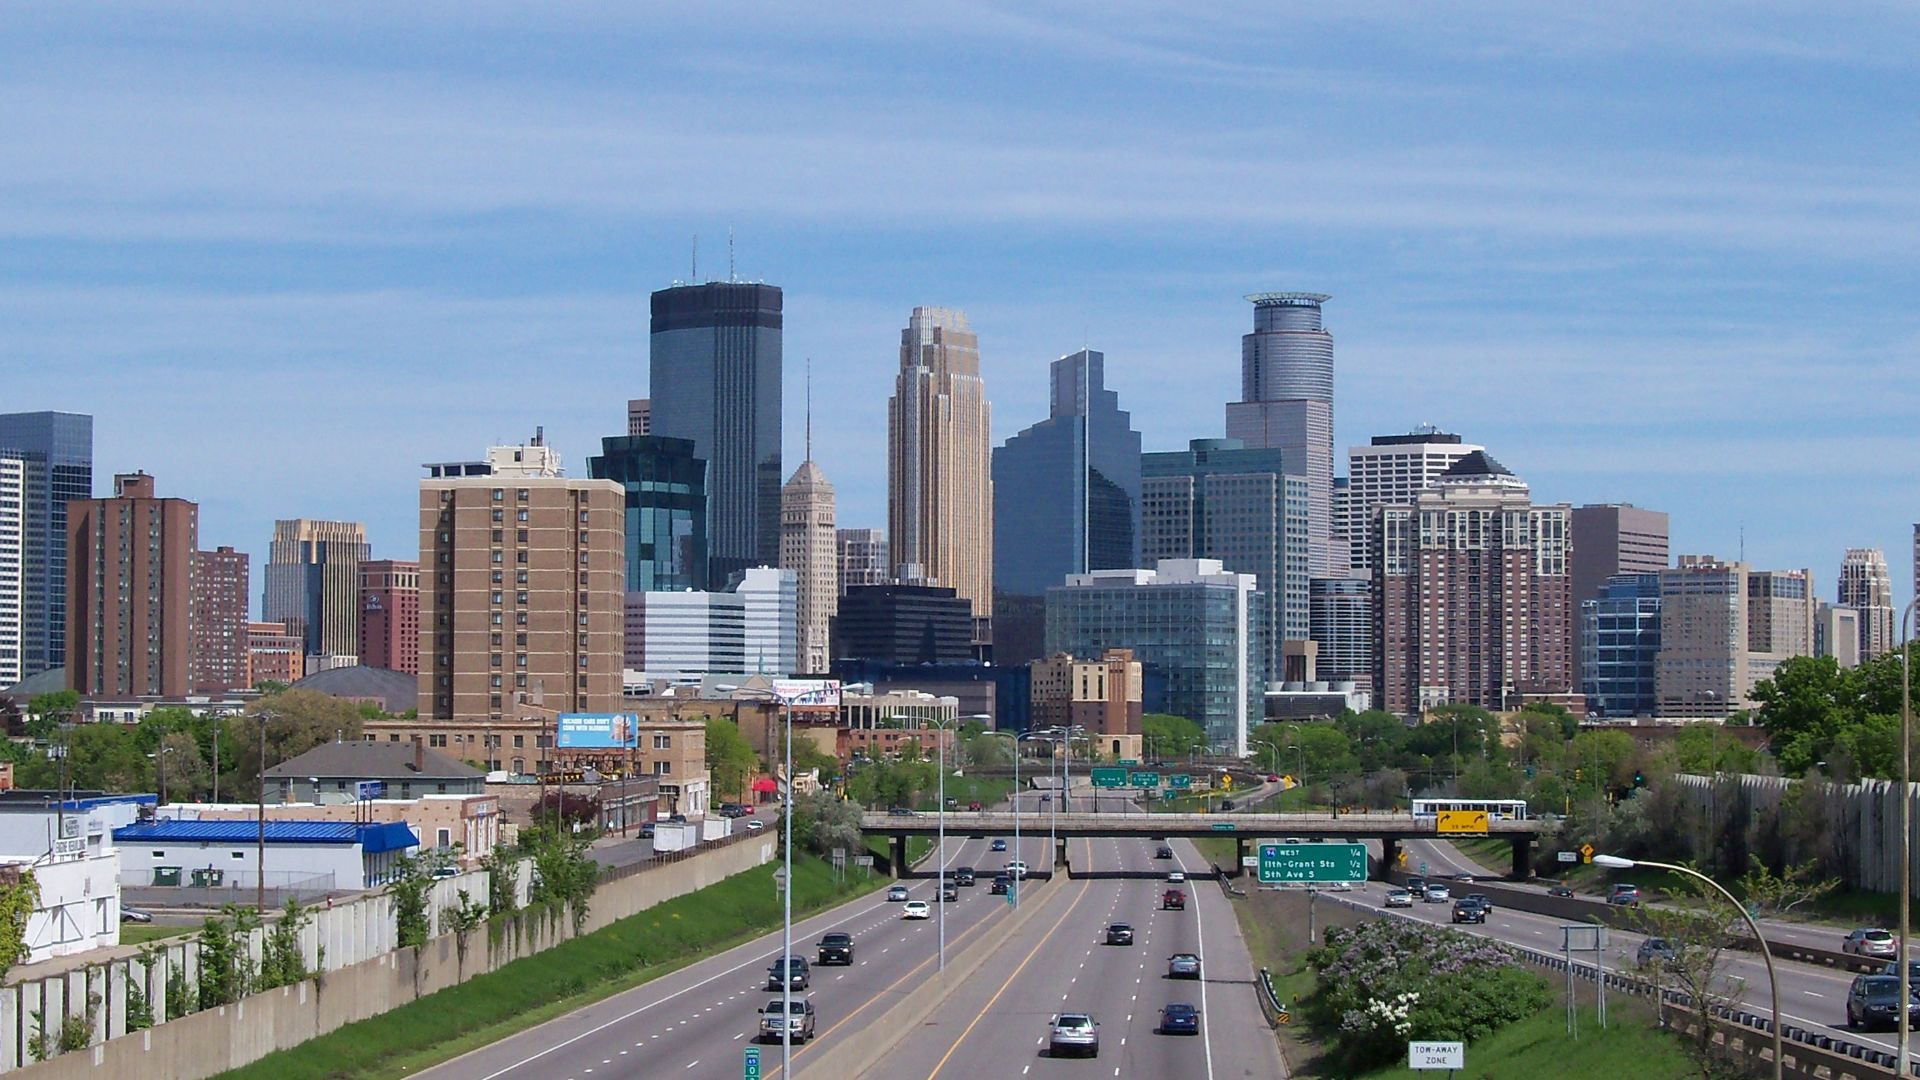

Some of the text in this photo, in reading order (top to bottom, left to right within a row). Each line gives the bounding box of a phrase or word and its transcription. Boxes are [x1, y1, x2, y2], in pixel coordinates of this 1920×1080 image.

[1350, 848, 1361, 857] 1/4
[1264, 860, 1315, 868] 11th-Grant
[1320, 860, 1335, 868] Sts
[1350, 860, 1361, 868] 1/2
[1415, 1046, 1458, 1054] TOW-AWAY
[1425, 1056, 1448, 1065] ZONE
[749, 1066, 756, 1075] 0
